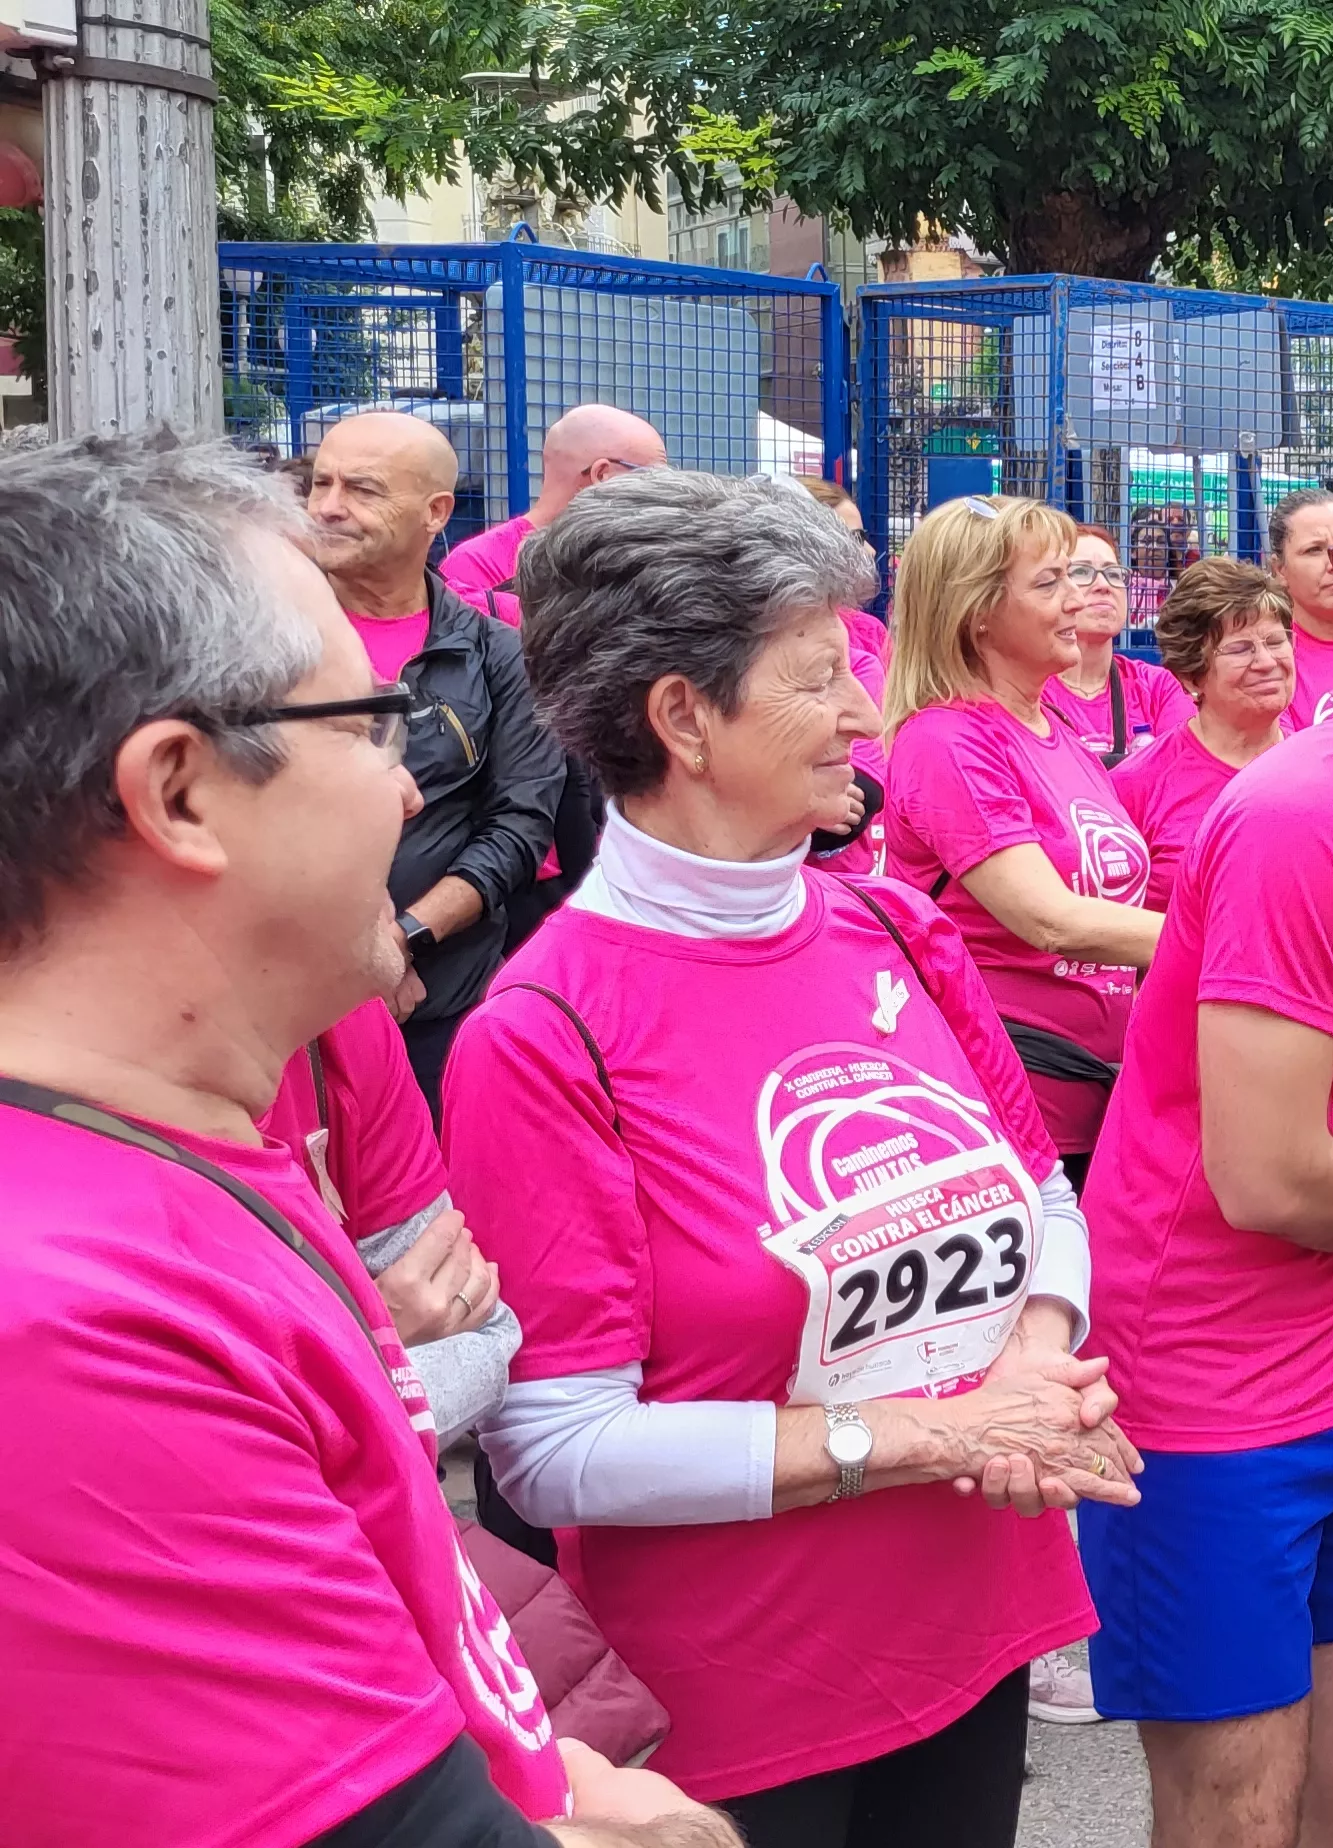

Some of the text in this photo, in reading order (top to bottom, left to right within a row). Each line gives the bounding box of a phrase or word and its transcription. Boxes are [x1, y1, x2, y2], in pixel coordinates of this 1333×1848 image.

[1135, 331, 1141, 347] 8
[1135, 352, 1143, 369] 4
[794, 1065, 843, 1088] CARRERA
[795, 1078, 839, 1098] CONTRA
[839, 1075, 853, 1086] EL
[831, 1132, 918, 1177] Caminemos
[885, 1187, 944, 1218] HUESCA
[830, 1183, 1015, 1263] CONTRA EL CÁNCER
[830, 1217, 1027, 1352] 2923
